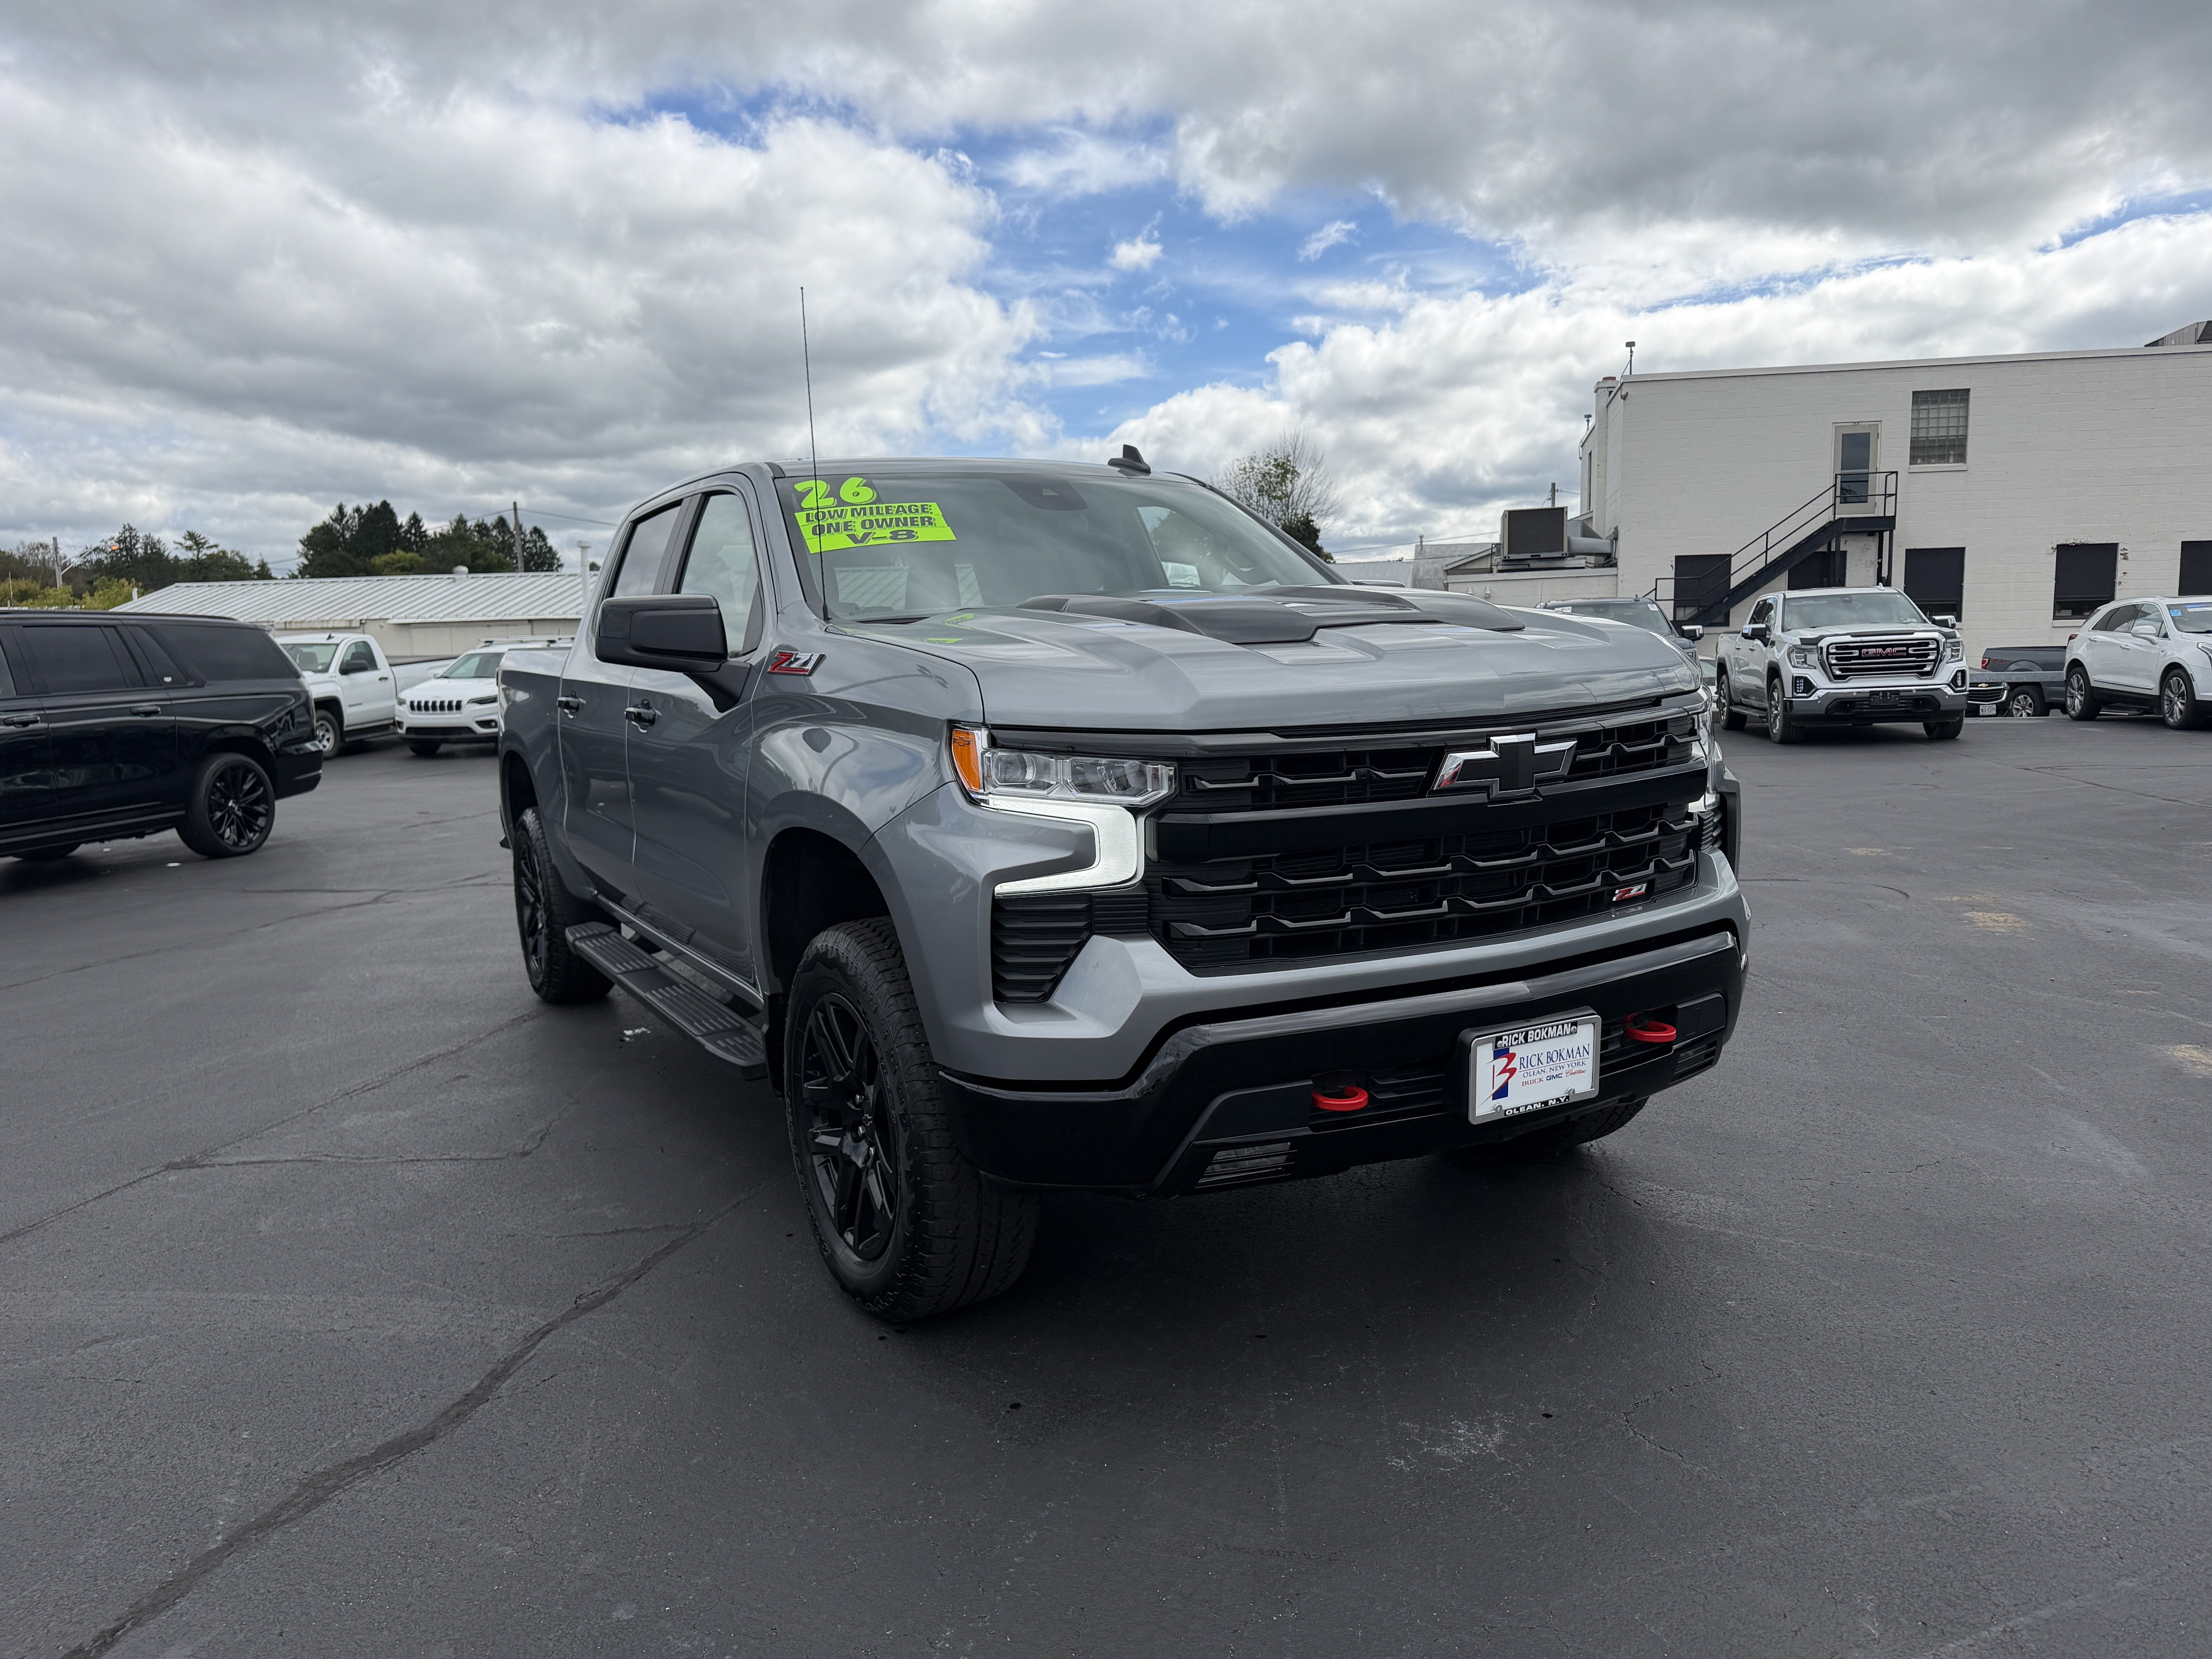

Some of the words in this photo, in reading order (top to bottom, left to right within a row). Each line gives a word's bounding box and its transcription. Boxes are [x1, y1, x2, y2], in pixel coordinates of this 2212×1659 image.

[794, 477, 877, 508] 26
[805, 508, 847, 523] LOW
[851, 504, 933, 518] MILEAGE
[812, 520, 855, 536] ONE
[861, 516, 936, 530] OWNER
[846, 529, 919, 544] V-8
[1862, 647, 1906, 657] GMC
[1502, 1032, 1525, 1047] RICK
[1527, 1023, 1571, 1042] BOKMAN
[1519, 1053, 1544, 1070] RICK
[1546, 1044, 1590, 1065] BOKMAN
[1549, 1064, 1565, 1072] NEW
[1567, 1060, 1586, 1068] YORK
[1522, 1077, 1544, 1086] BUICK
[1565, 1068, 1586, 1077] Cadillac
[1548, 1096, 1568, 1106] N.Y.
